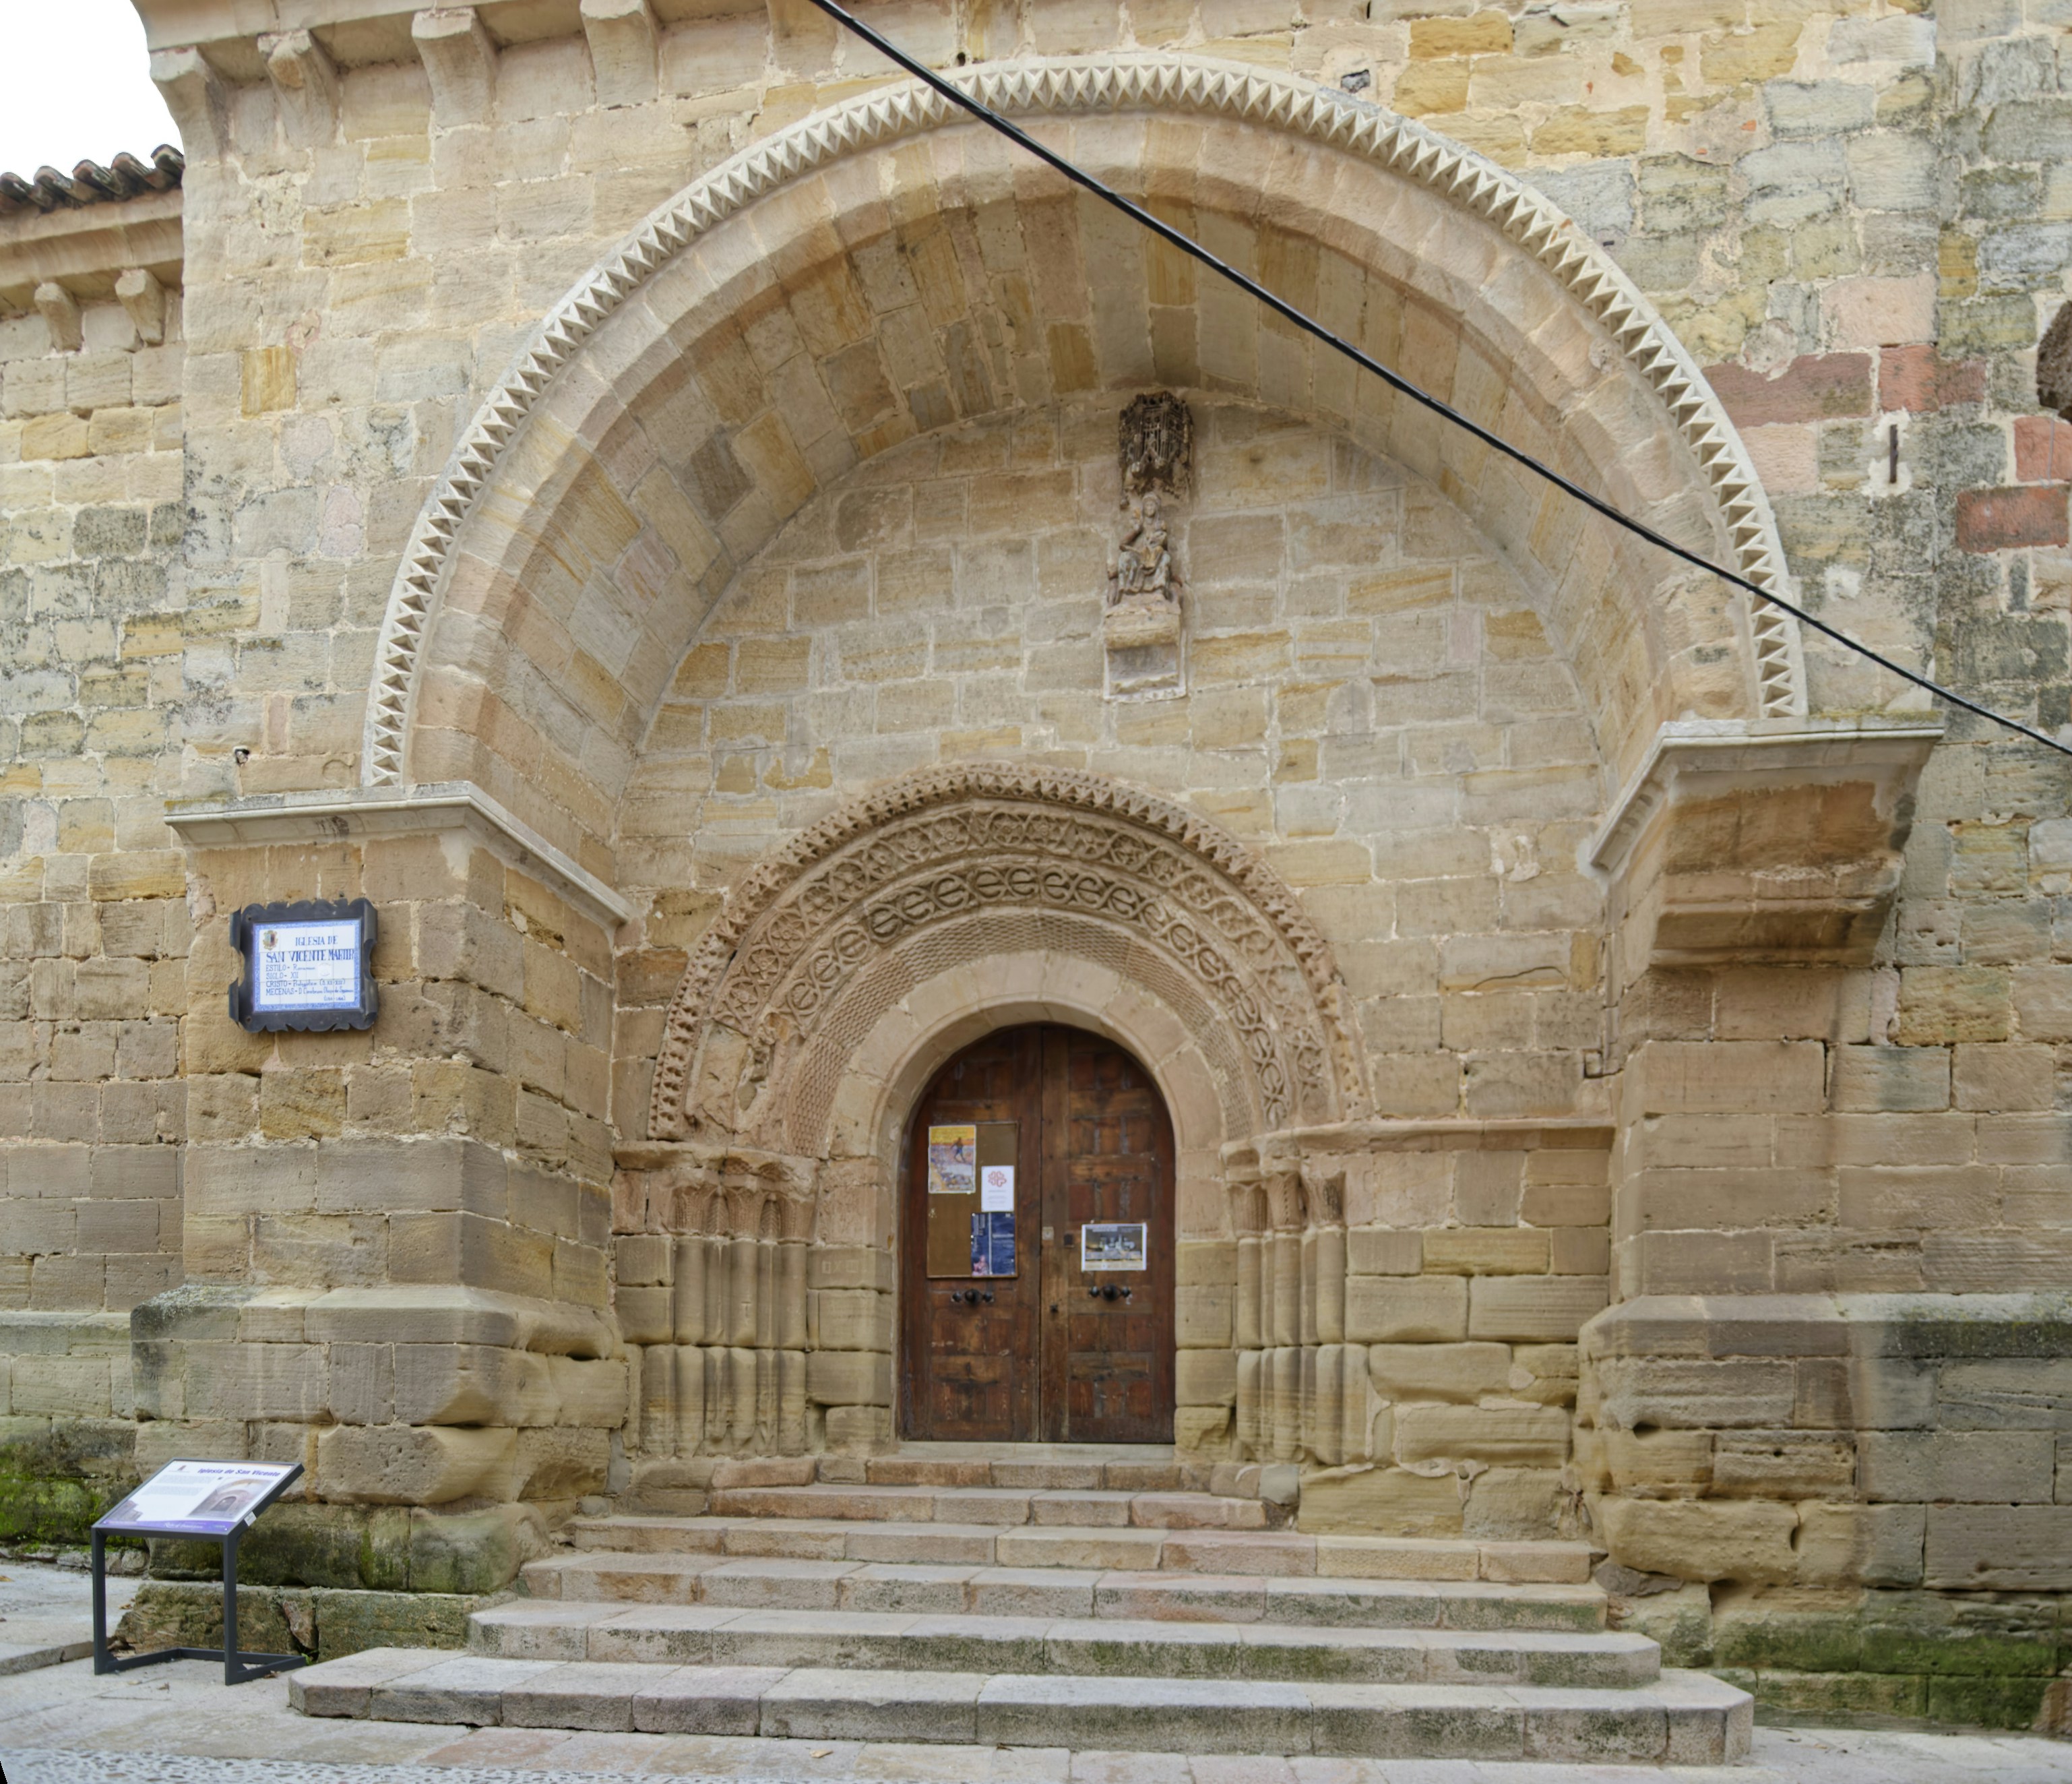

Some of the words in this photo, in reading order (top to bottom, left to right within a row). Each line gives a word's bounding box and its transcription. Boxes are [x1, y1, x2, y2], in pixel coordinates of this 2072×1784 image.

[295, 936, 325, 946] IGLESIA
[327, 935, 339, 945] DE
[265, 951, 285, 963] SAN
[288, 949, 327, 962] VICENTE
